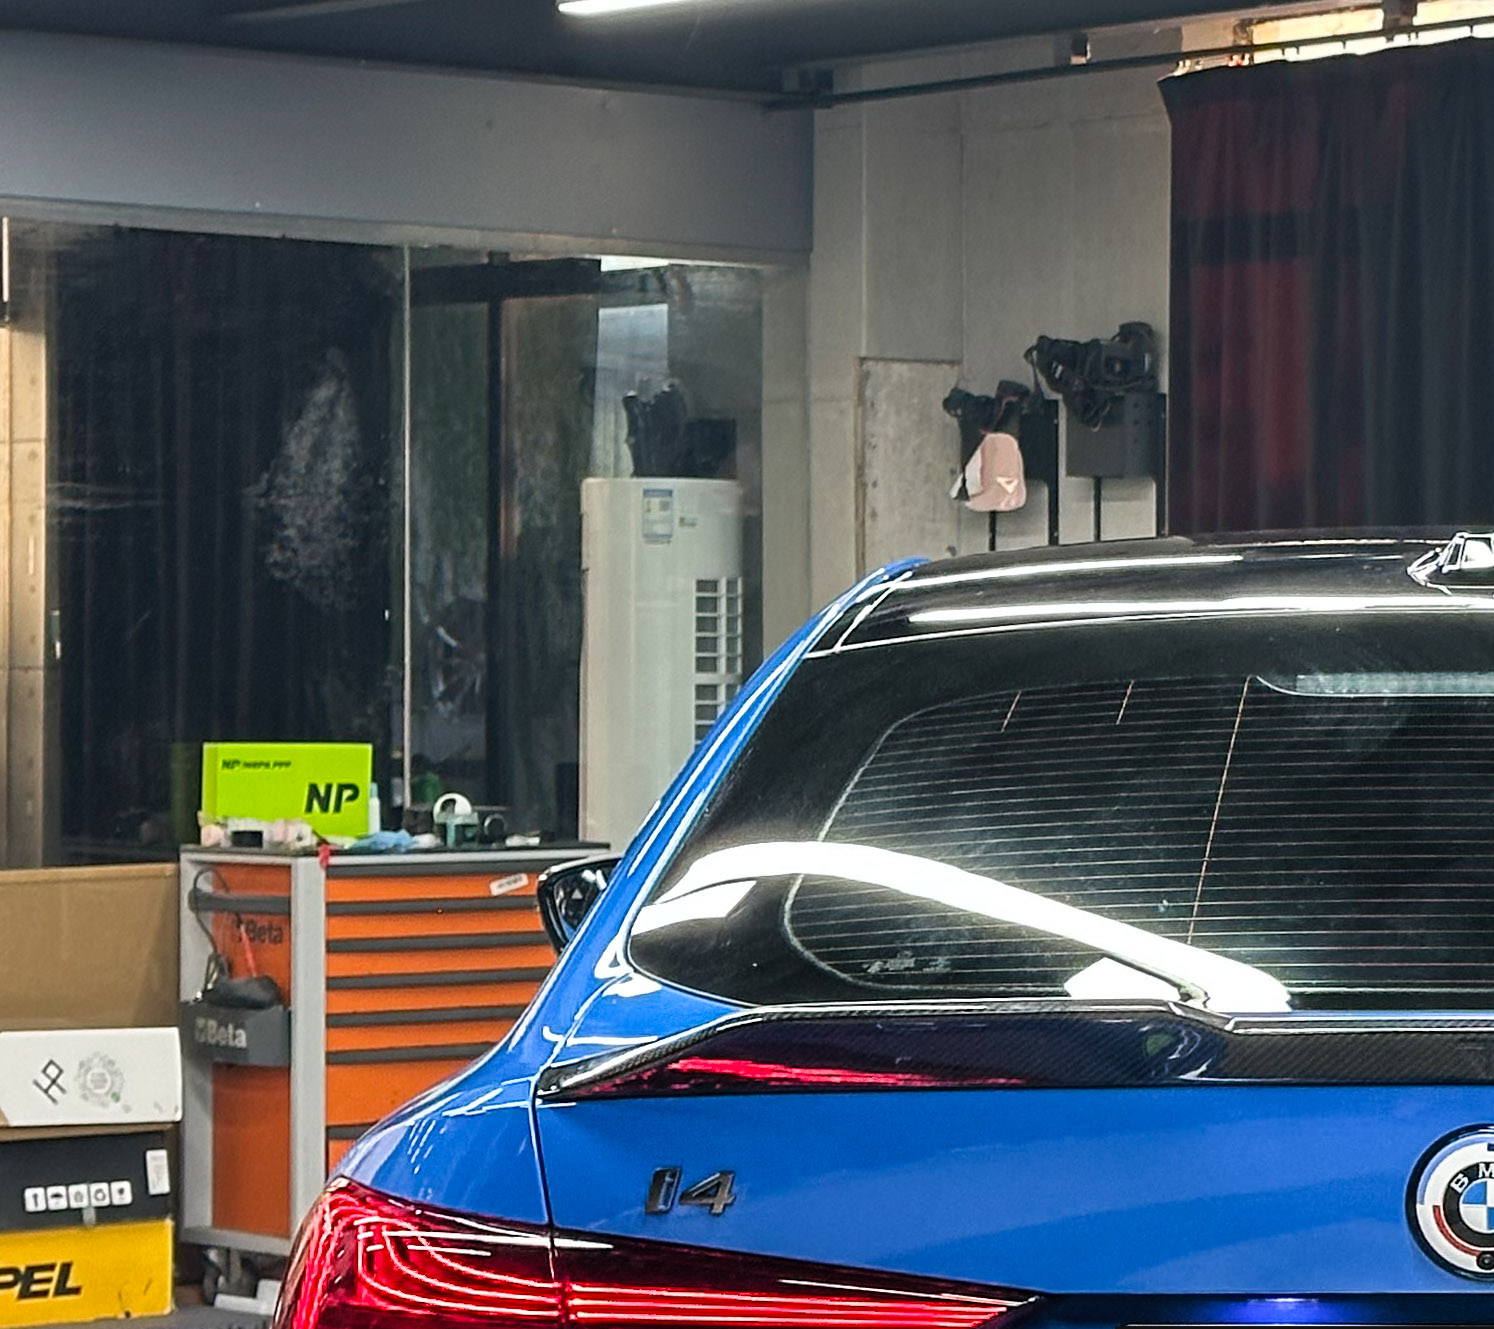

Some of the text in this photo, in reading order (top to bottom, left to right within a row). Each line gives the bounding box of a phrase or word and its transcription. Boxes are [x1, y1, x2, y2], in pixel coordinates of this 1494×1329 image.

[305, 782, 360, 814] NP
[246, 920, 284, 945] Beta
[207, 1020, 247, 1049] Beta
[645, 1166, 736, 1216] i4
